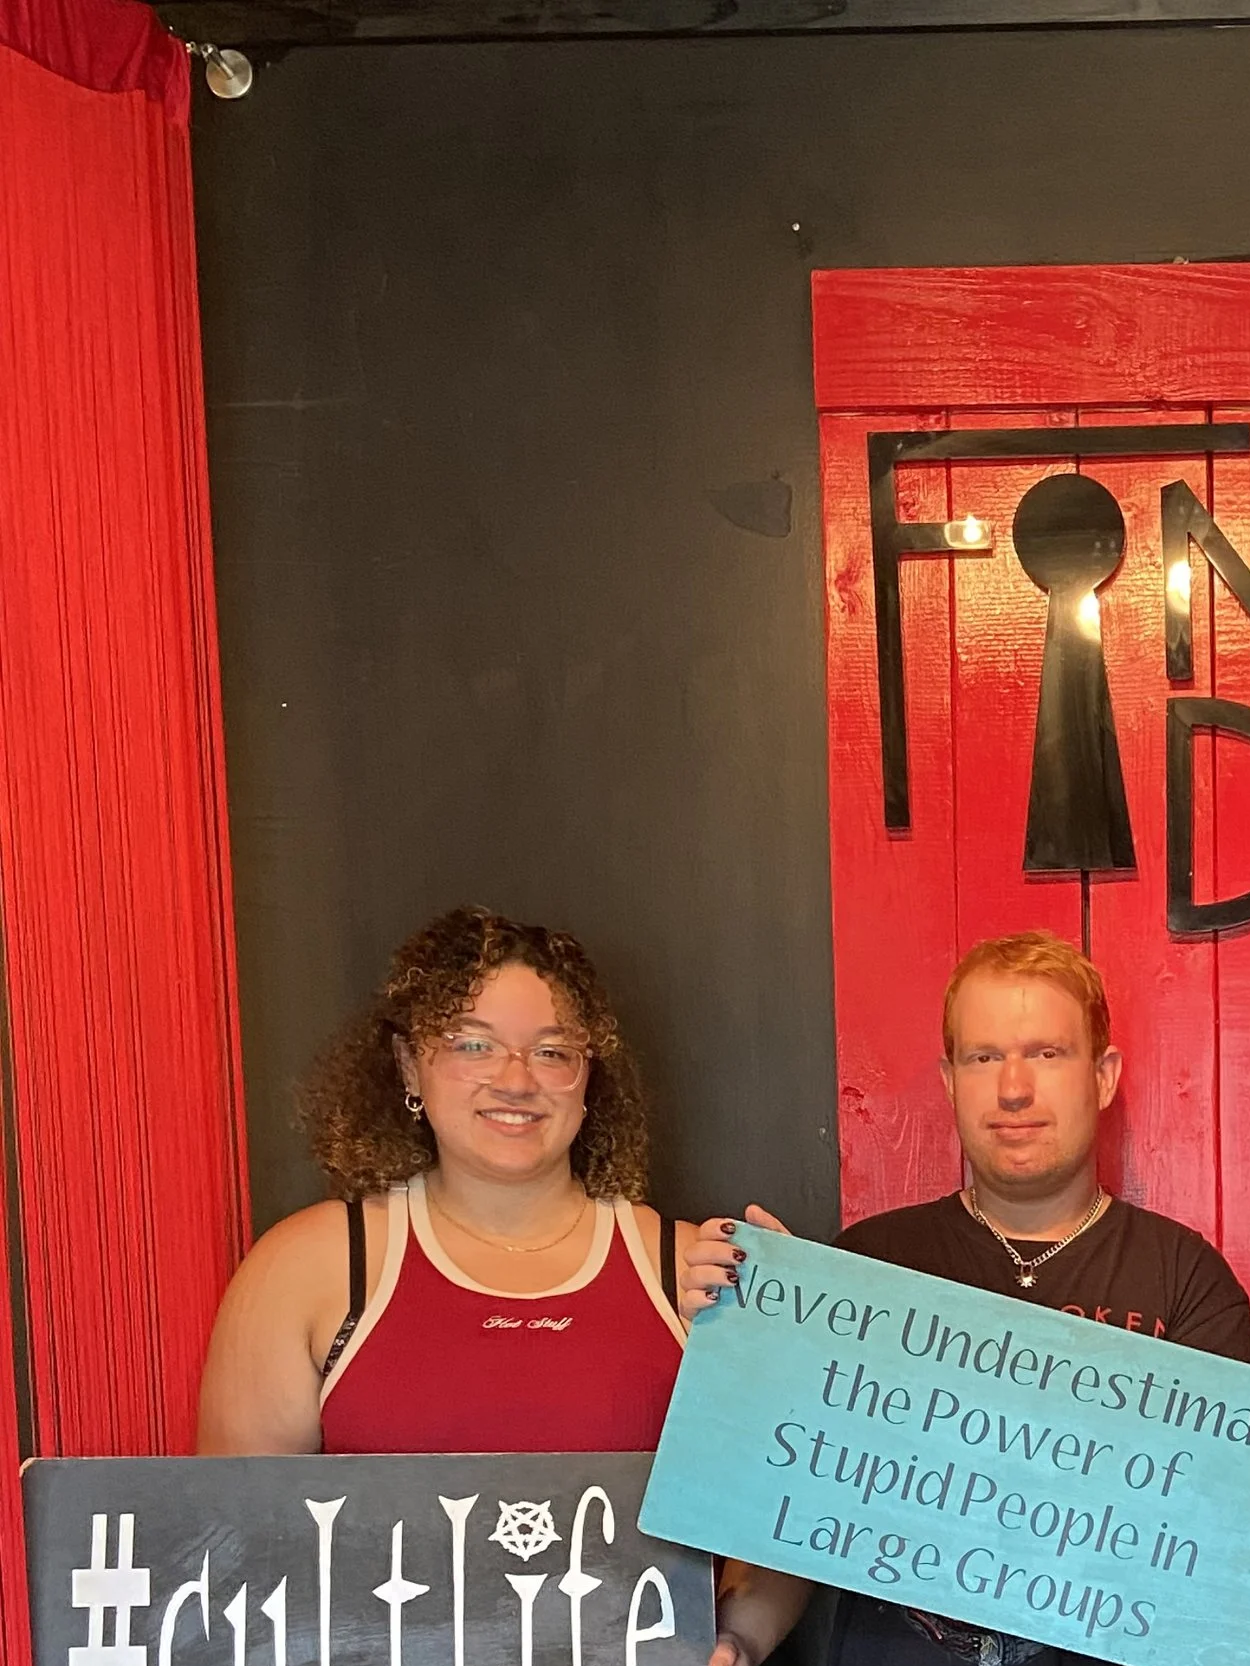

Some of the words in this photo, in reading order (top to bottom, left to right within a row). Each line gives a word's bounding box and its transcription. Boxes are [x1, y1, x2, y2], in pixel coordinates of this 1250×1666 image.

[766, 1420, 955, 1511] Stupid
[961, 1471, 1140, 1560] People
[1150, 1521, 1200, 1577] in
[823, 1358, 912, 1425] the
[923, 1388, 1115, 1478] Power
[1124, 1450, 1194, 1498] of
[773, 1495, 942, 1585] Large
[956, 1546, 1157, 1639] Groups
